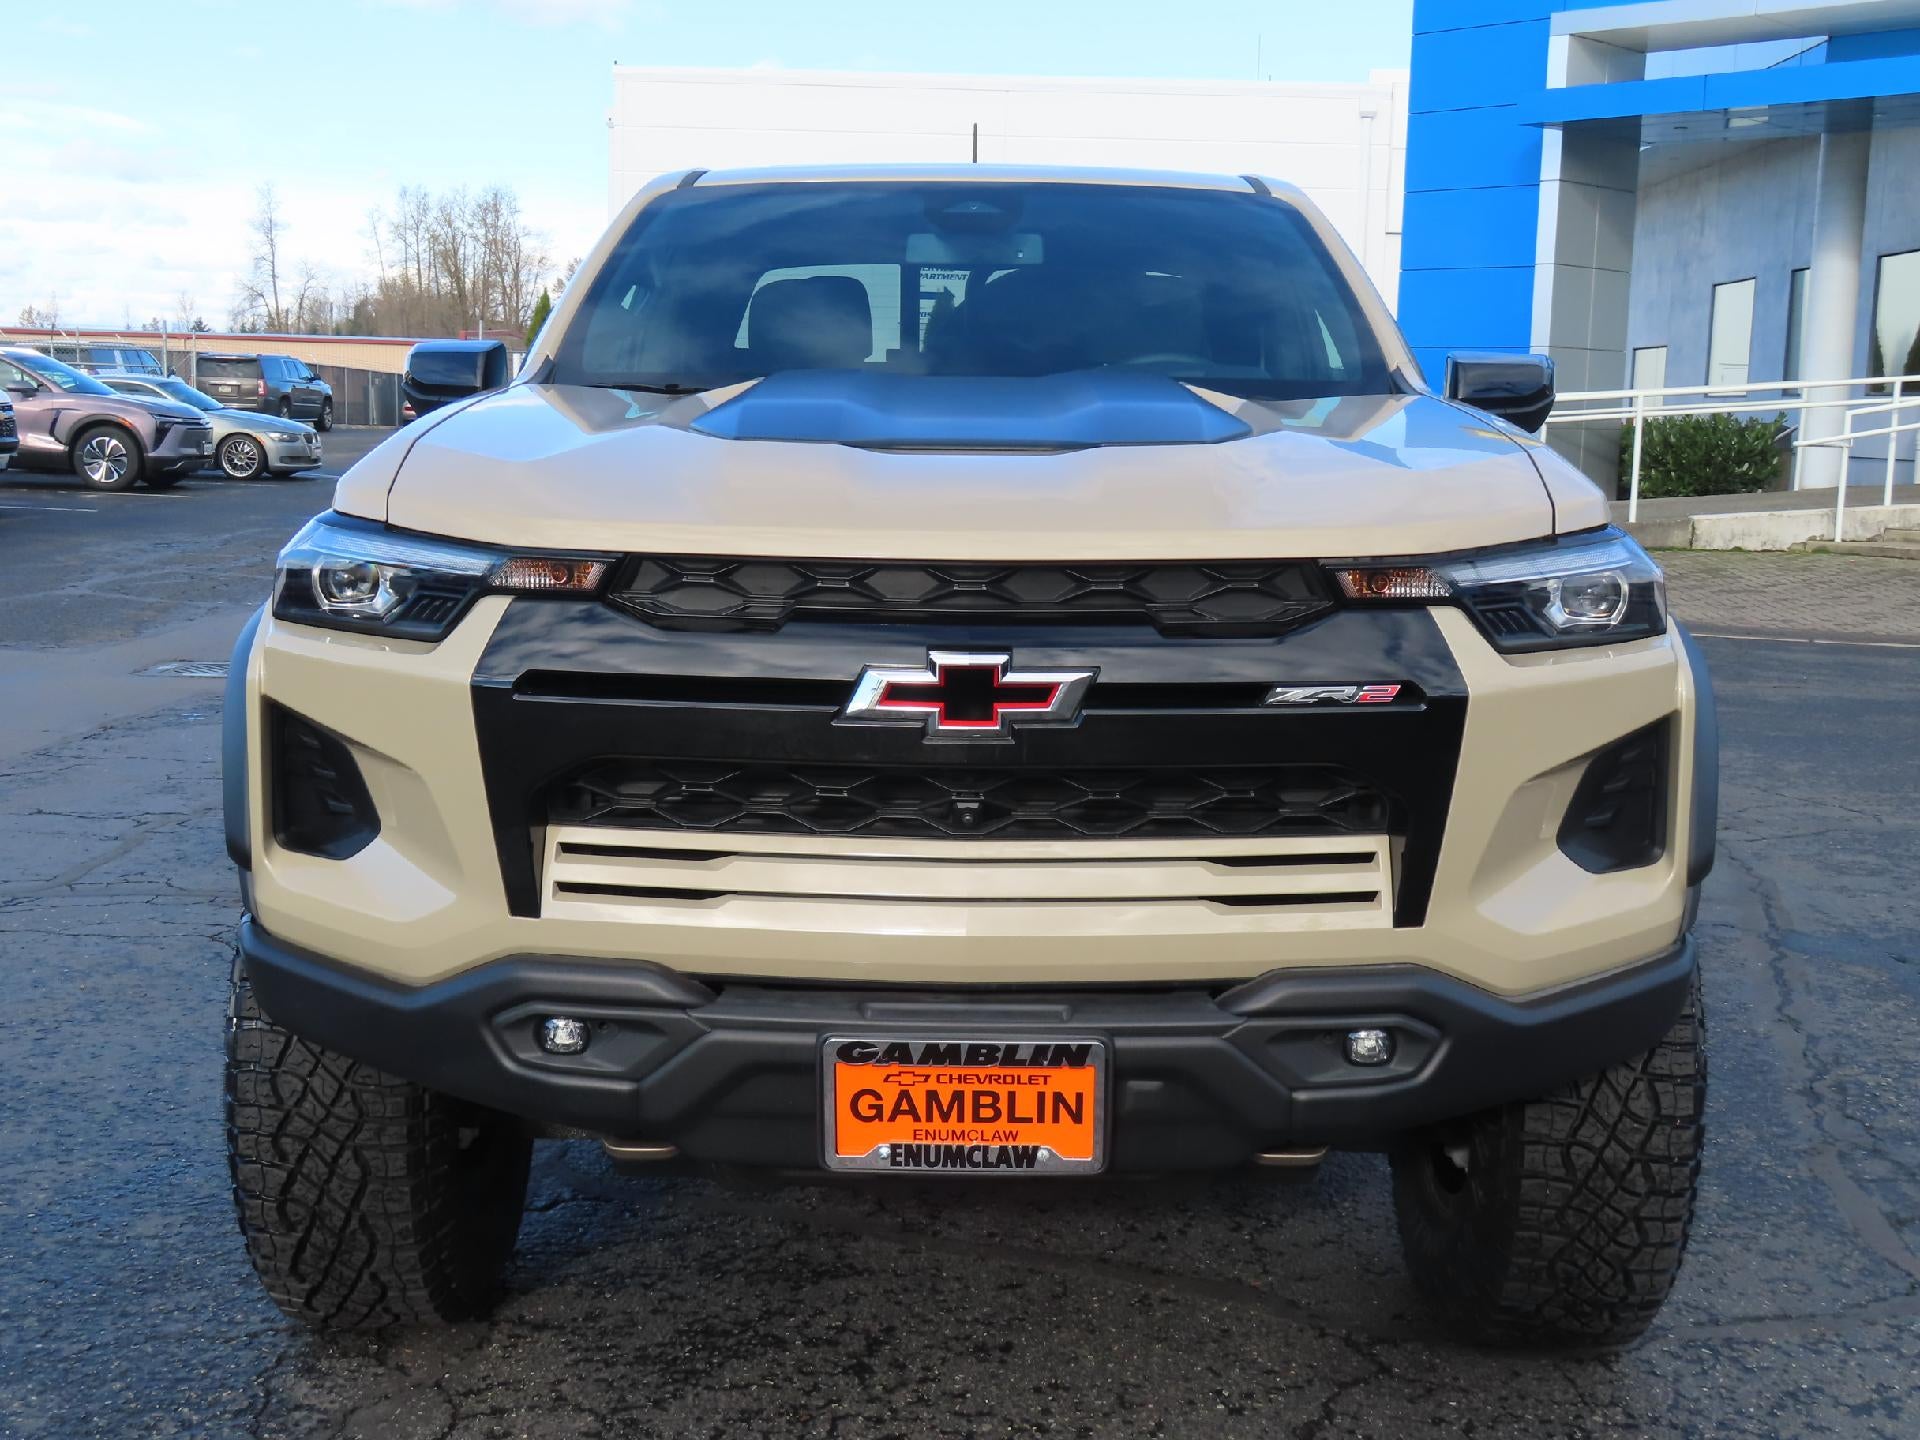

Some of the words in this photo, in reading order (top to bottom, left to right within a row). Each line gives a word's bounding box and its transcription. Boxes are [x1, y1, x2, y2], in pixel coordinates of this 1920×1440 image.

[1265, 685, 1401, 705] ZR2
[836, 1041, 1092, 1066] GAMBLIN
[936, 1073, 1051, 1085] CHEVROLET
[850, 1089, 1083, 1124] GAMBLIN
[913, 1129, 1019, 1142] ENUMCLAW
[890, 1144, 1040, 1168] ENUMCLAW
